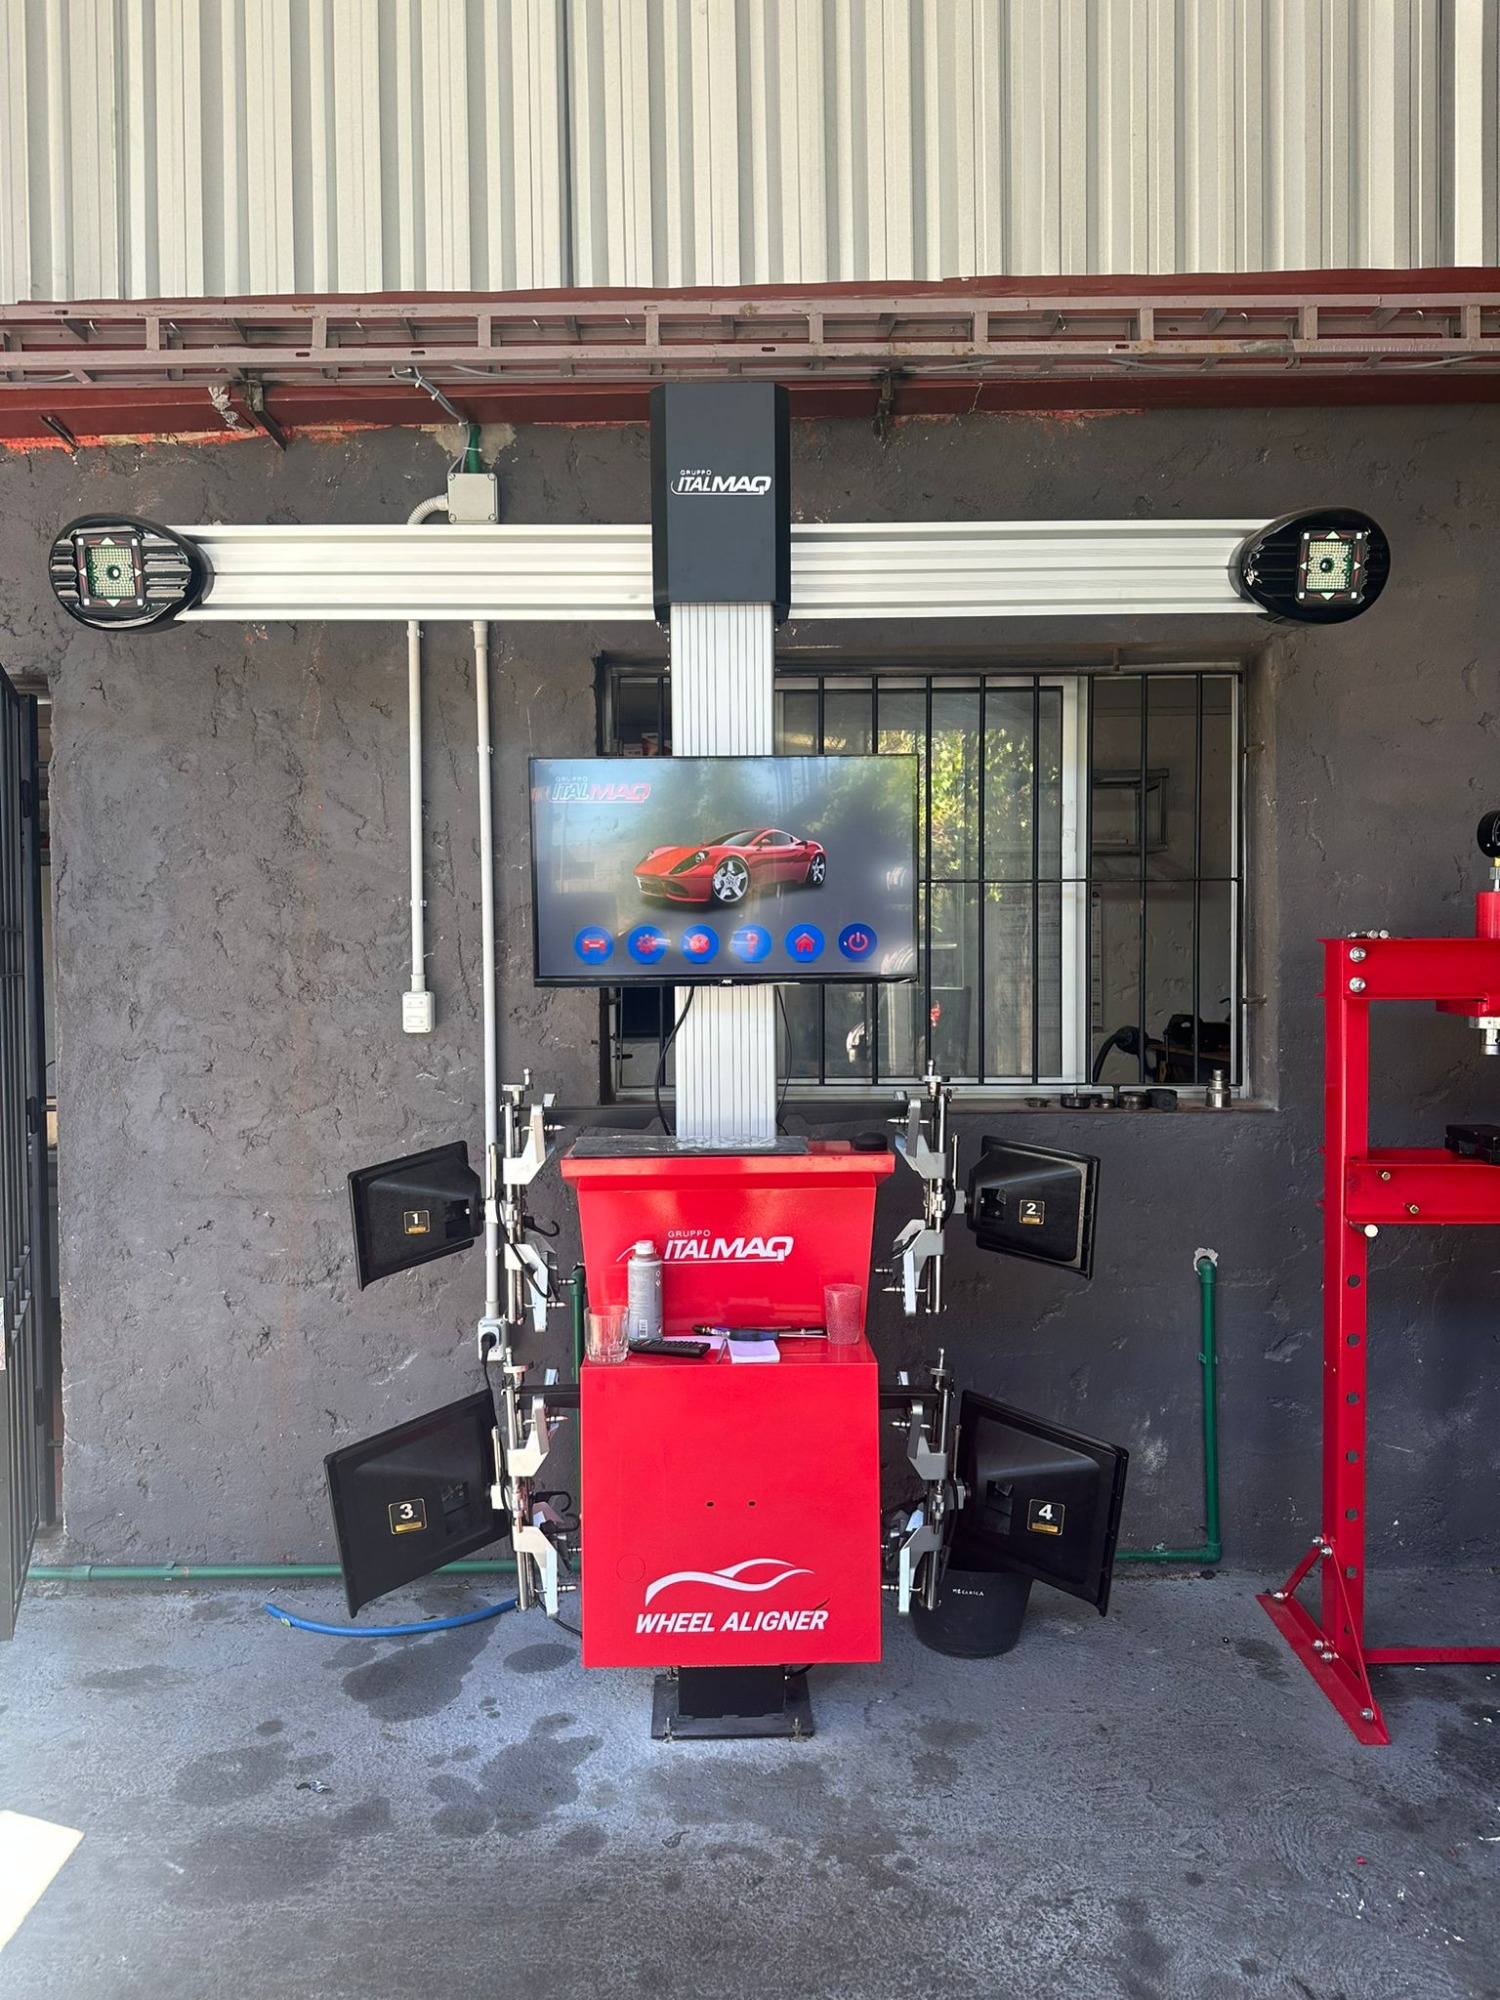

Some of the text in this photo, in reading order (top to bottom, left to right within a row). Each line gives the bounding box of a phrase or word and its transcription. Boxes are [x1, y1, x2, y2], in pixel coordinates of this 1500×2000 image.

[677, 476, 772, 495] ITALMAQ
[551, 782, 652, 803] ITALMAQ
[1026, 1202, 1037, 1215] 2
[412, 1212, 419, 1225] 1
[667, 1229, 711, 1238] GRUPPO
[663, 1236, 794, 1261] ITALMAQ
[400, 1503, 414, 1520] 3
[1038, 1504, 1053, 1520] 4
[635, 1610, 829, 1634] WHEEL ALIGNER
